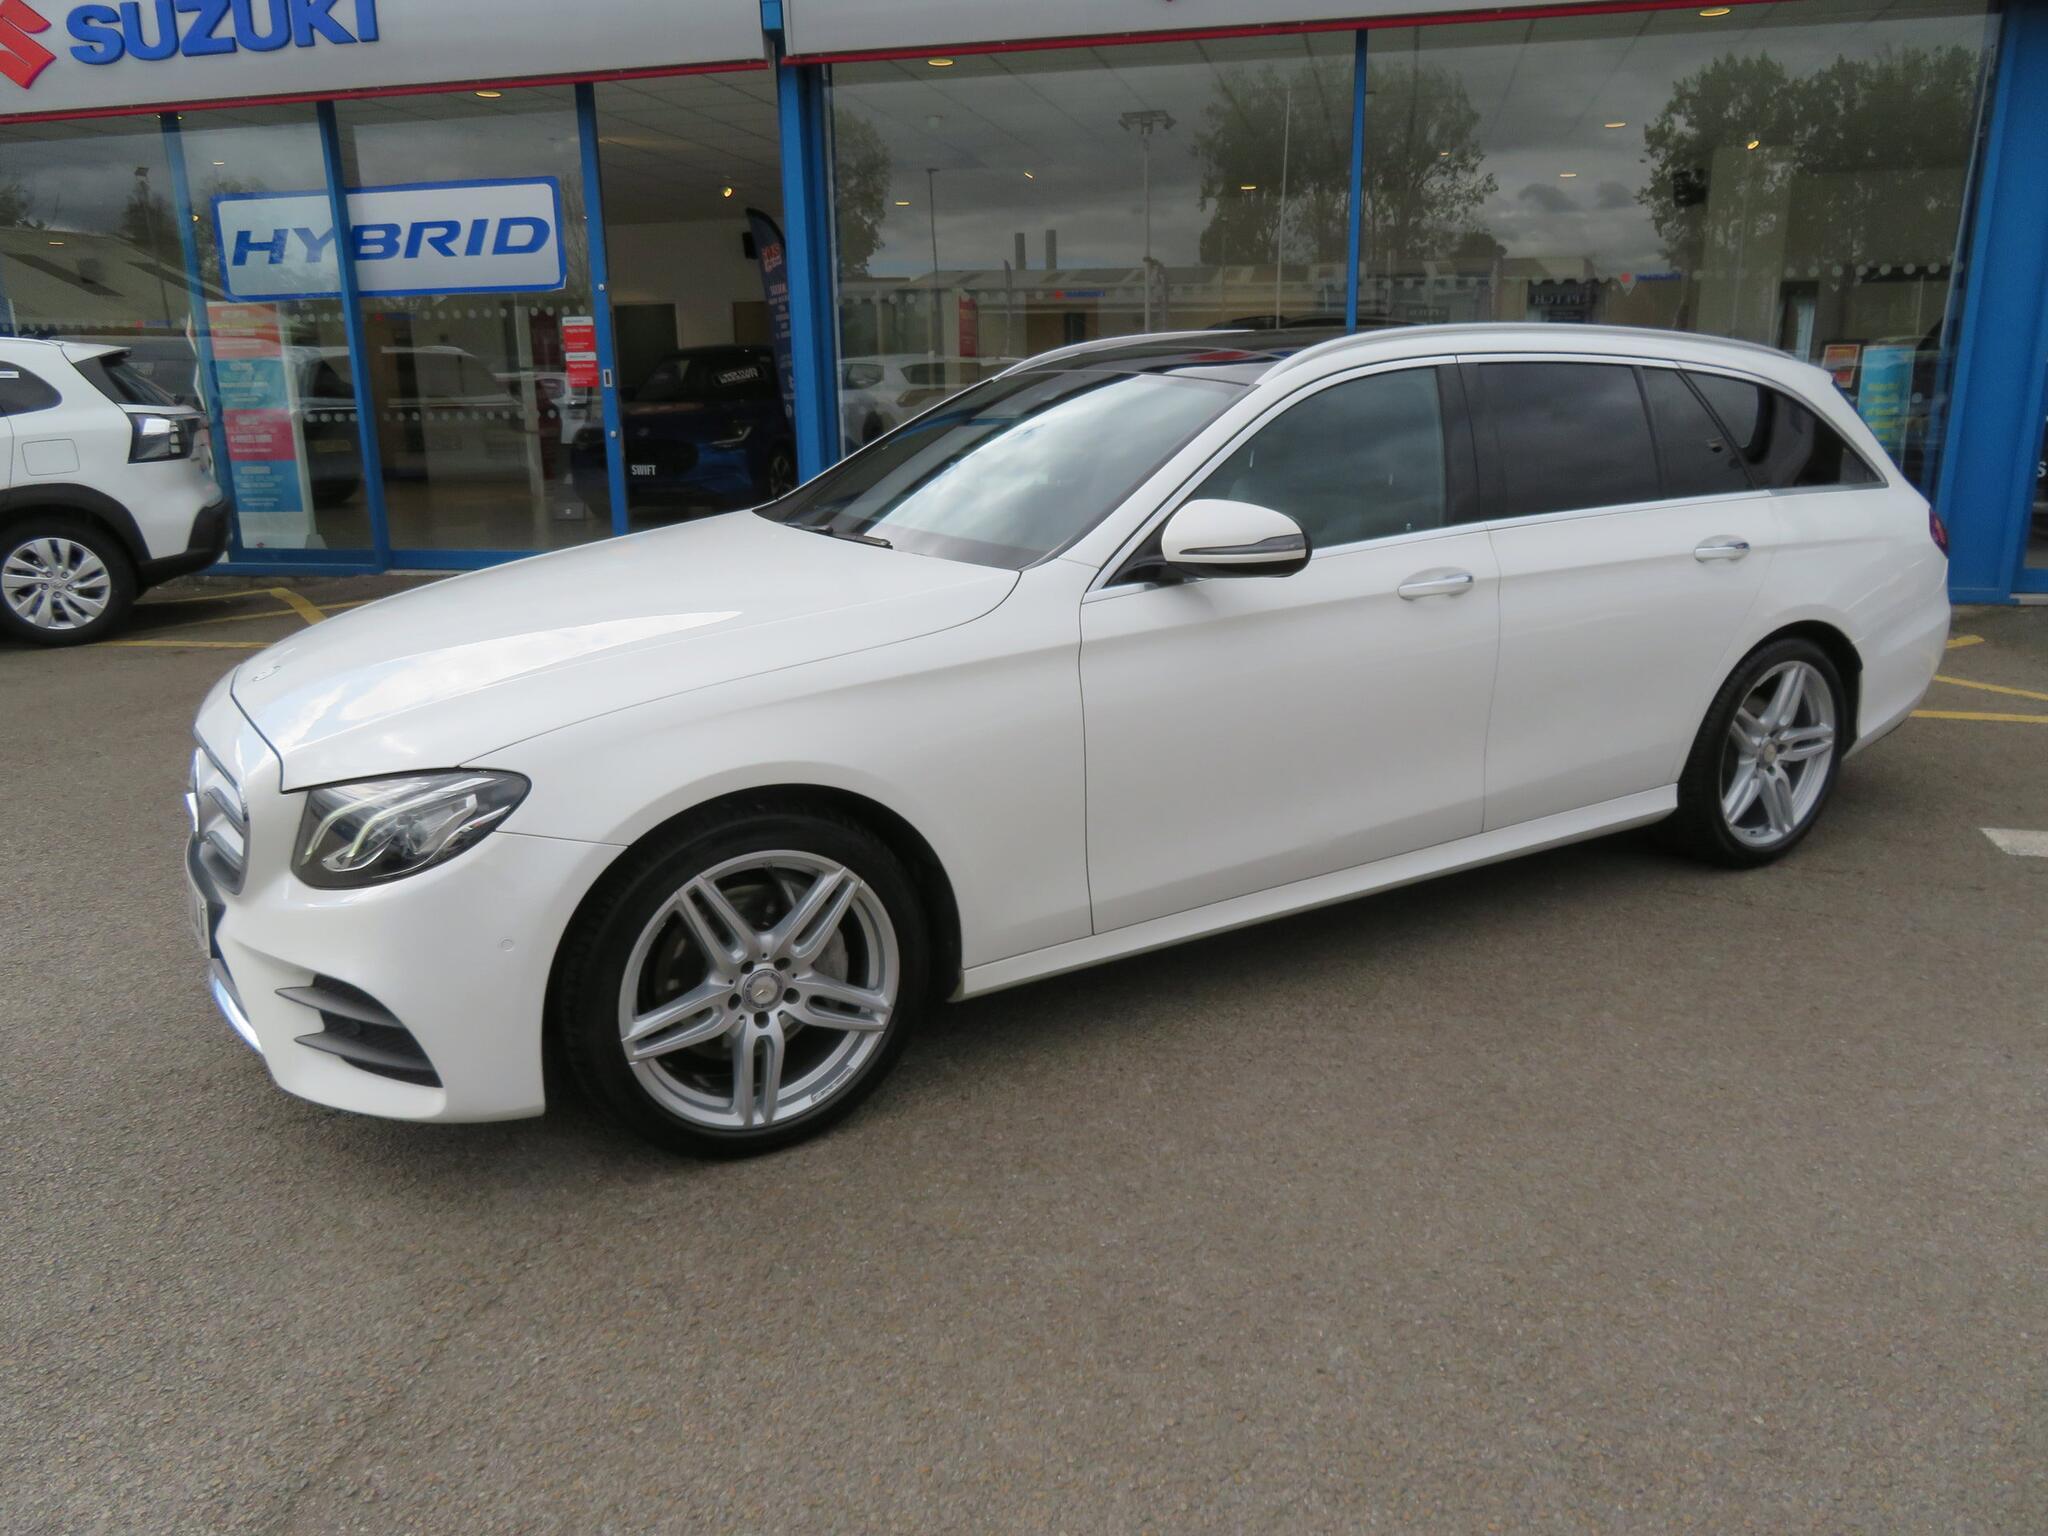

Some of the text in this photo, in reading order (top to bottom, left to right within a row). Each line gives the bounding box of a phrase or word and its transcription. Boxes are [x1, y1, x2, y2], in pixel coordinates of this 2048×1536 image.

[66, 0, 379, 65] SUZUKI
[232, 217, 550, 267] HYBRID
[631, 464, 657, 475] SWIFT
